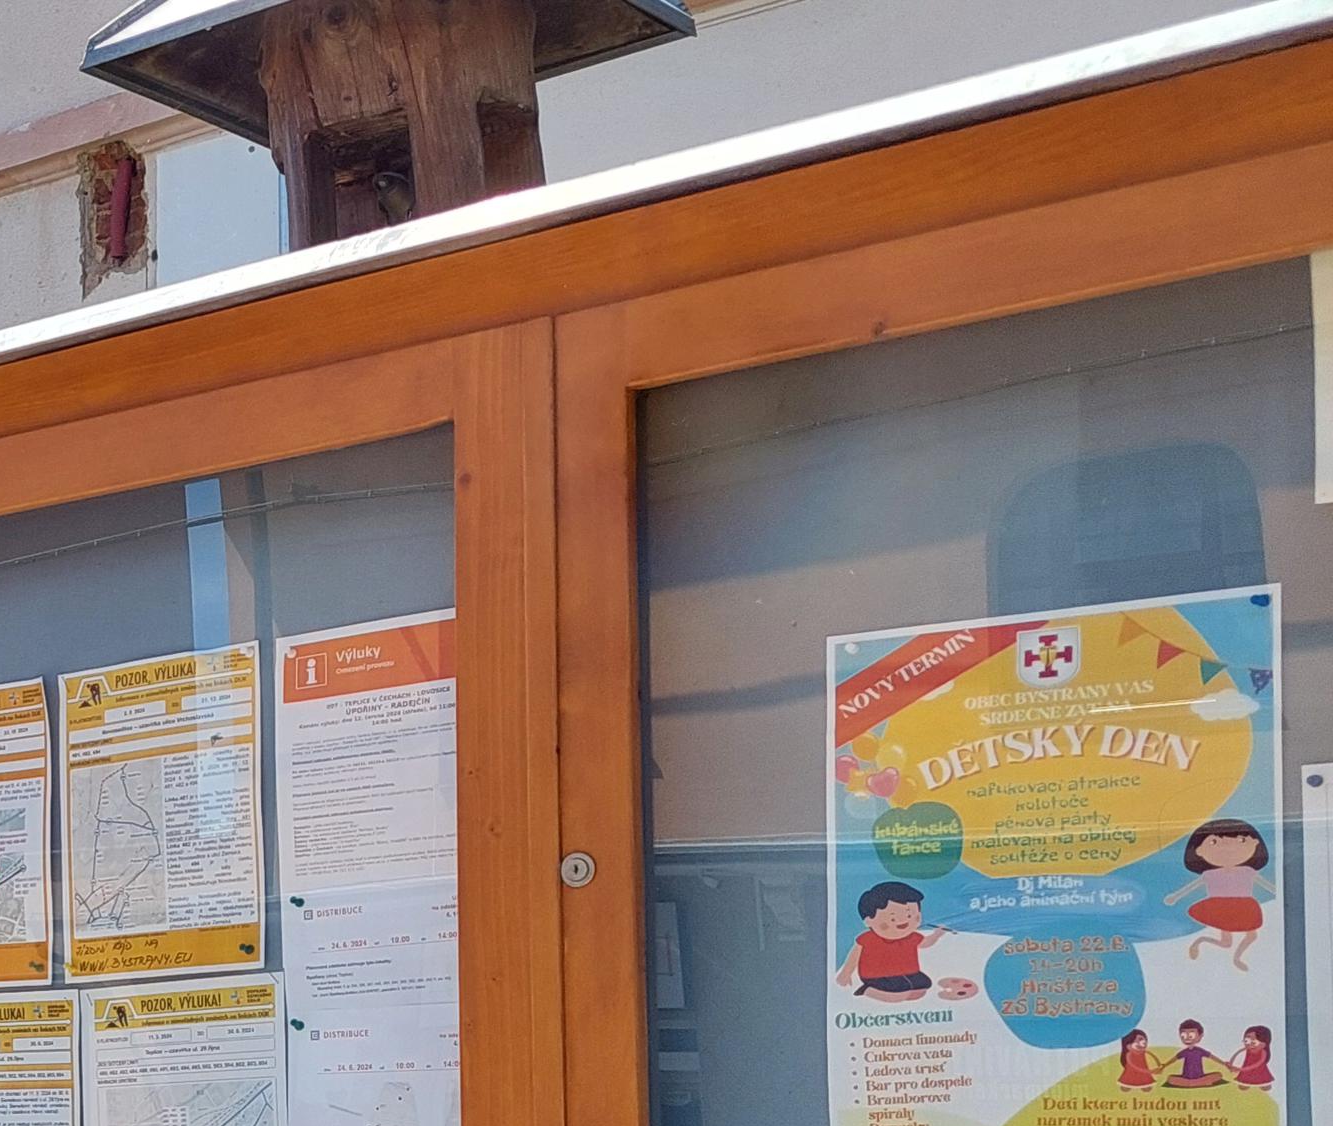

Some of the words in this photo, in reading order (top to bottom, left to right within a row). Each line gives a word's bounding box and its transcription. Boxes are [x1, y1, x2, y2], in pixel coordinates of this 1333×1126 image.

[336, 645, 381, 664] Výluky
[896, 629, 975, 682] TERMIN
[115, 670, 151, 688] POZOR,
[155, 661, 197, 680] VÝLUKA!
[964, 694, 1011, 710] OBEC
[1015, 684, 1111, 705] BYSTRANY
[917, 719, 1095, 791] DĚTSKÝ
[1099, 724, 1201, 772] DEN
[1068, 775, 1141, 791] atrakce
[1052, 834, 1074, 844] na
[1064, 851, 1074, 860] o
[1078, 848, 1122, 861] ceny
[1017, 877, 1034, 895] Dj
[1038, 876, 1084, 890] Milan
[1100, 889, 1133, 906] tým
[316, 906, 363, 918] DISTRIBUCE
[1003, 937, 1073, 955] sobota
[1093, 980, 1119, 993] za
[141, 998, 176, 1012] POZOR,
[179, 993, 222, 1009] VÝLUKA!
[323, 1030, 369, 1039] DISTRIBUCE
[864, 1051, 920, 1063] Cukrova
[923, 1048, 952, 1059] vata
[865, 1065, 911, 1078] Ledova
[866, 1080, 892, 1092] Bar
[895, 1081, 917, 1093] pro
[921, 1076, 972, 1090] dospele
[867, 1093, 951, 1106] Bramborove
[1082, 1098, 1127, 1110] ktere
[1132, 1097, 1187, 1110] budou
[869, 1108, 915, 1122] spiraly
[1037, 1114, 1112, 1126] naramek
